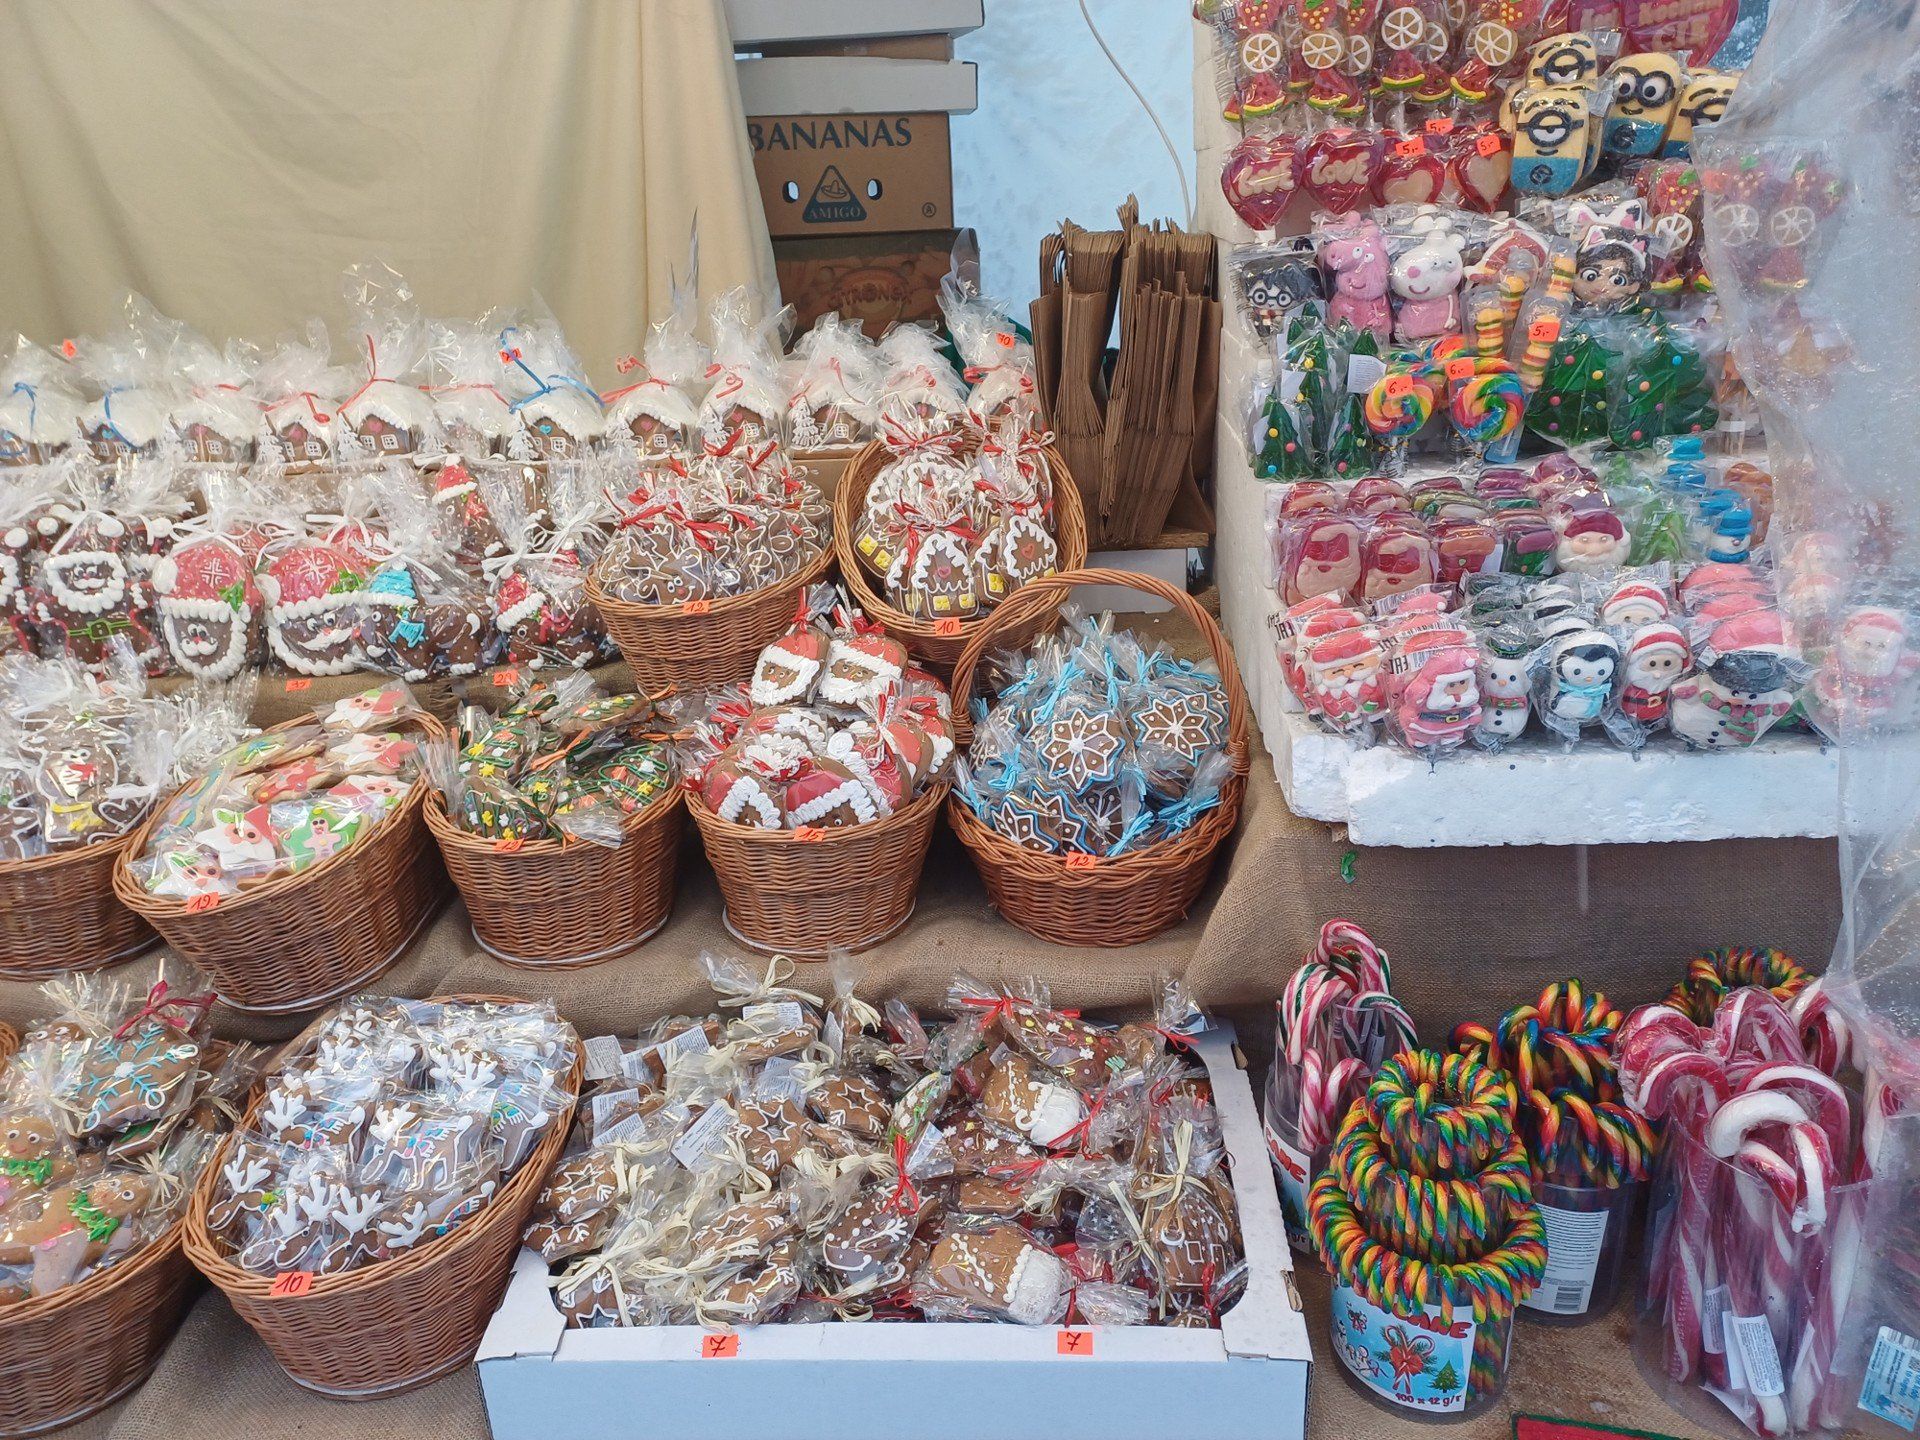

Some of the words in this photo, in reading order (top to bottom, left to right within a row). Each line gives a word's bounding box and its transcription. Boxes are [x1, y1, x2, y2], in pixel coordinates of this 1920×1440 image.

[748, 117, 912, 151] BANANAS
[808, 205, 861, 219] AMIGO
[937, 620, 954, 634] 10
[276, 1272, 304, 1293] 10
[710, 1335, 727, 1357] 7
[1066, 1332, 1082, 1351] 7
